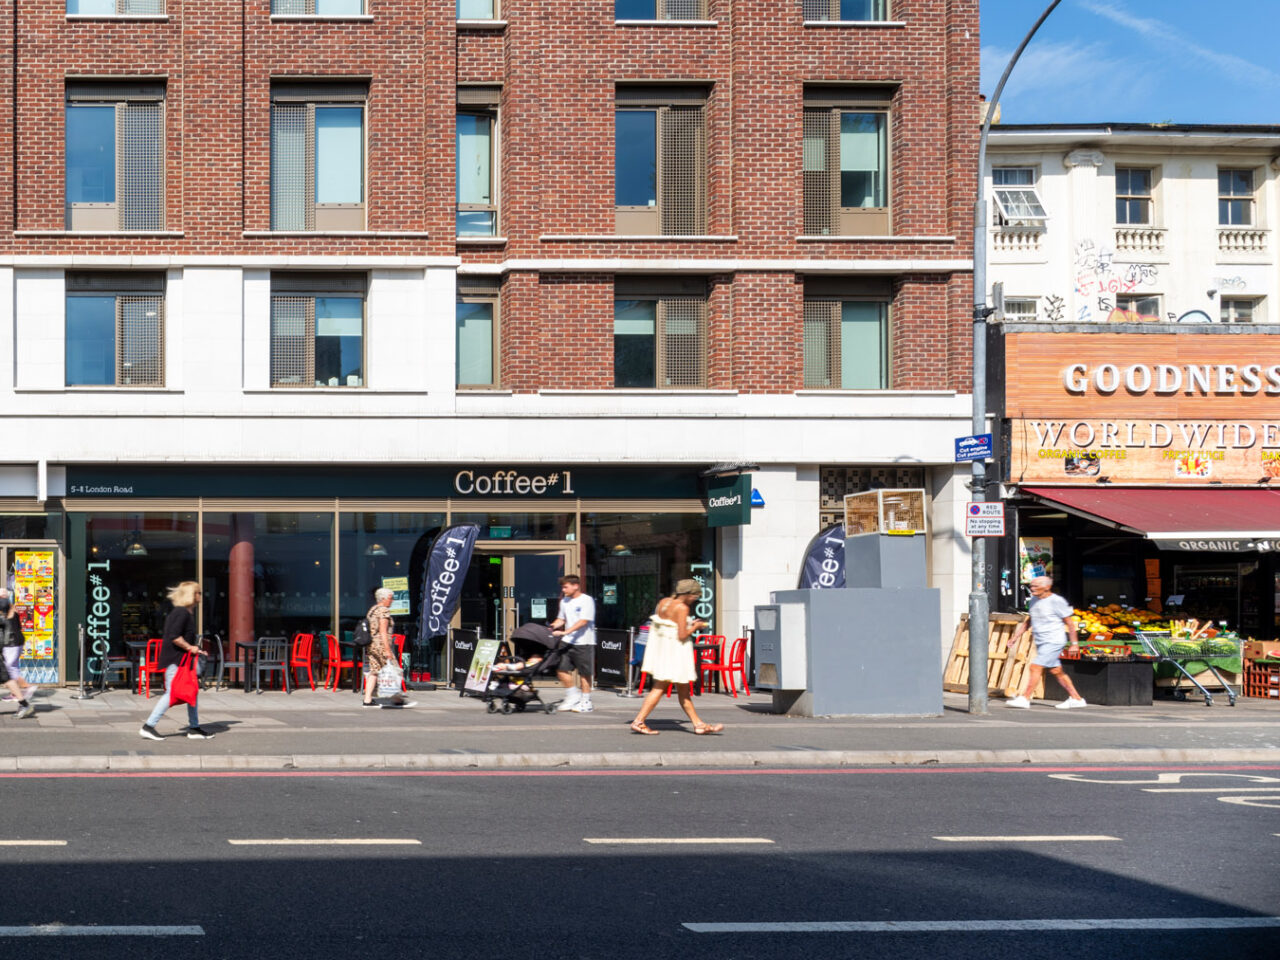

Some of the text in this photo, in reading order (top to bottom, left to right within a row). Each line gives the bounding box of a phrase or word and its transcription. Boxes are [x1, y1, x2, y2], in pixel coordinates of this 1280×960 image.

[1064, 363, 1280, 396] GOODNESS
[1030, 422, 1280, 448] WORLDWIDE
[1038, 449, 1127, 460] ORGANIC COFFEE
[1162, 450, 1225, 461] FRESH JUICE
[85, 485, 112, 493] London
[113, 485, 133, 493] Road
[455, 470, 575, 494] Coffee#1
[1178, 541, 1240, 550] ORGANIC
[428, 537, 467, 633] Coffee#1
